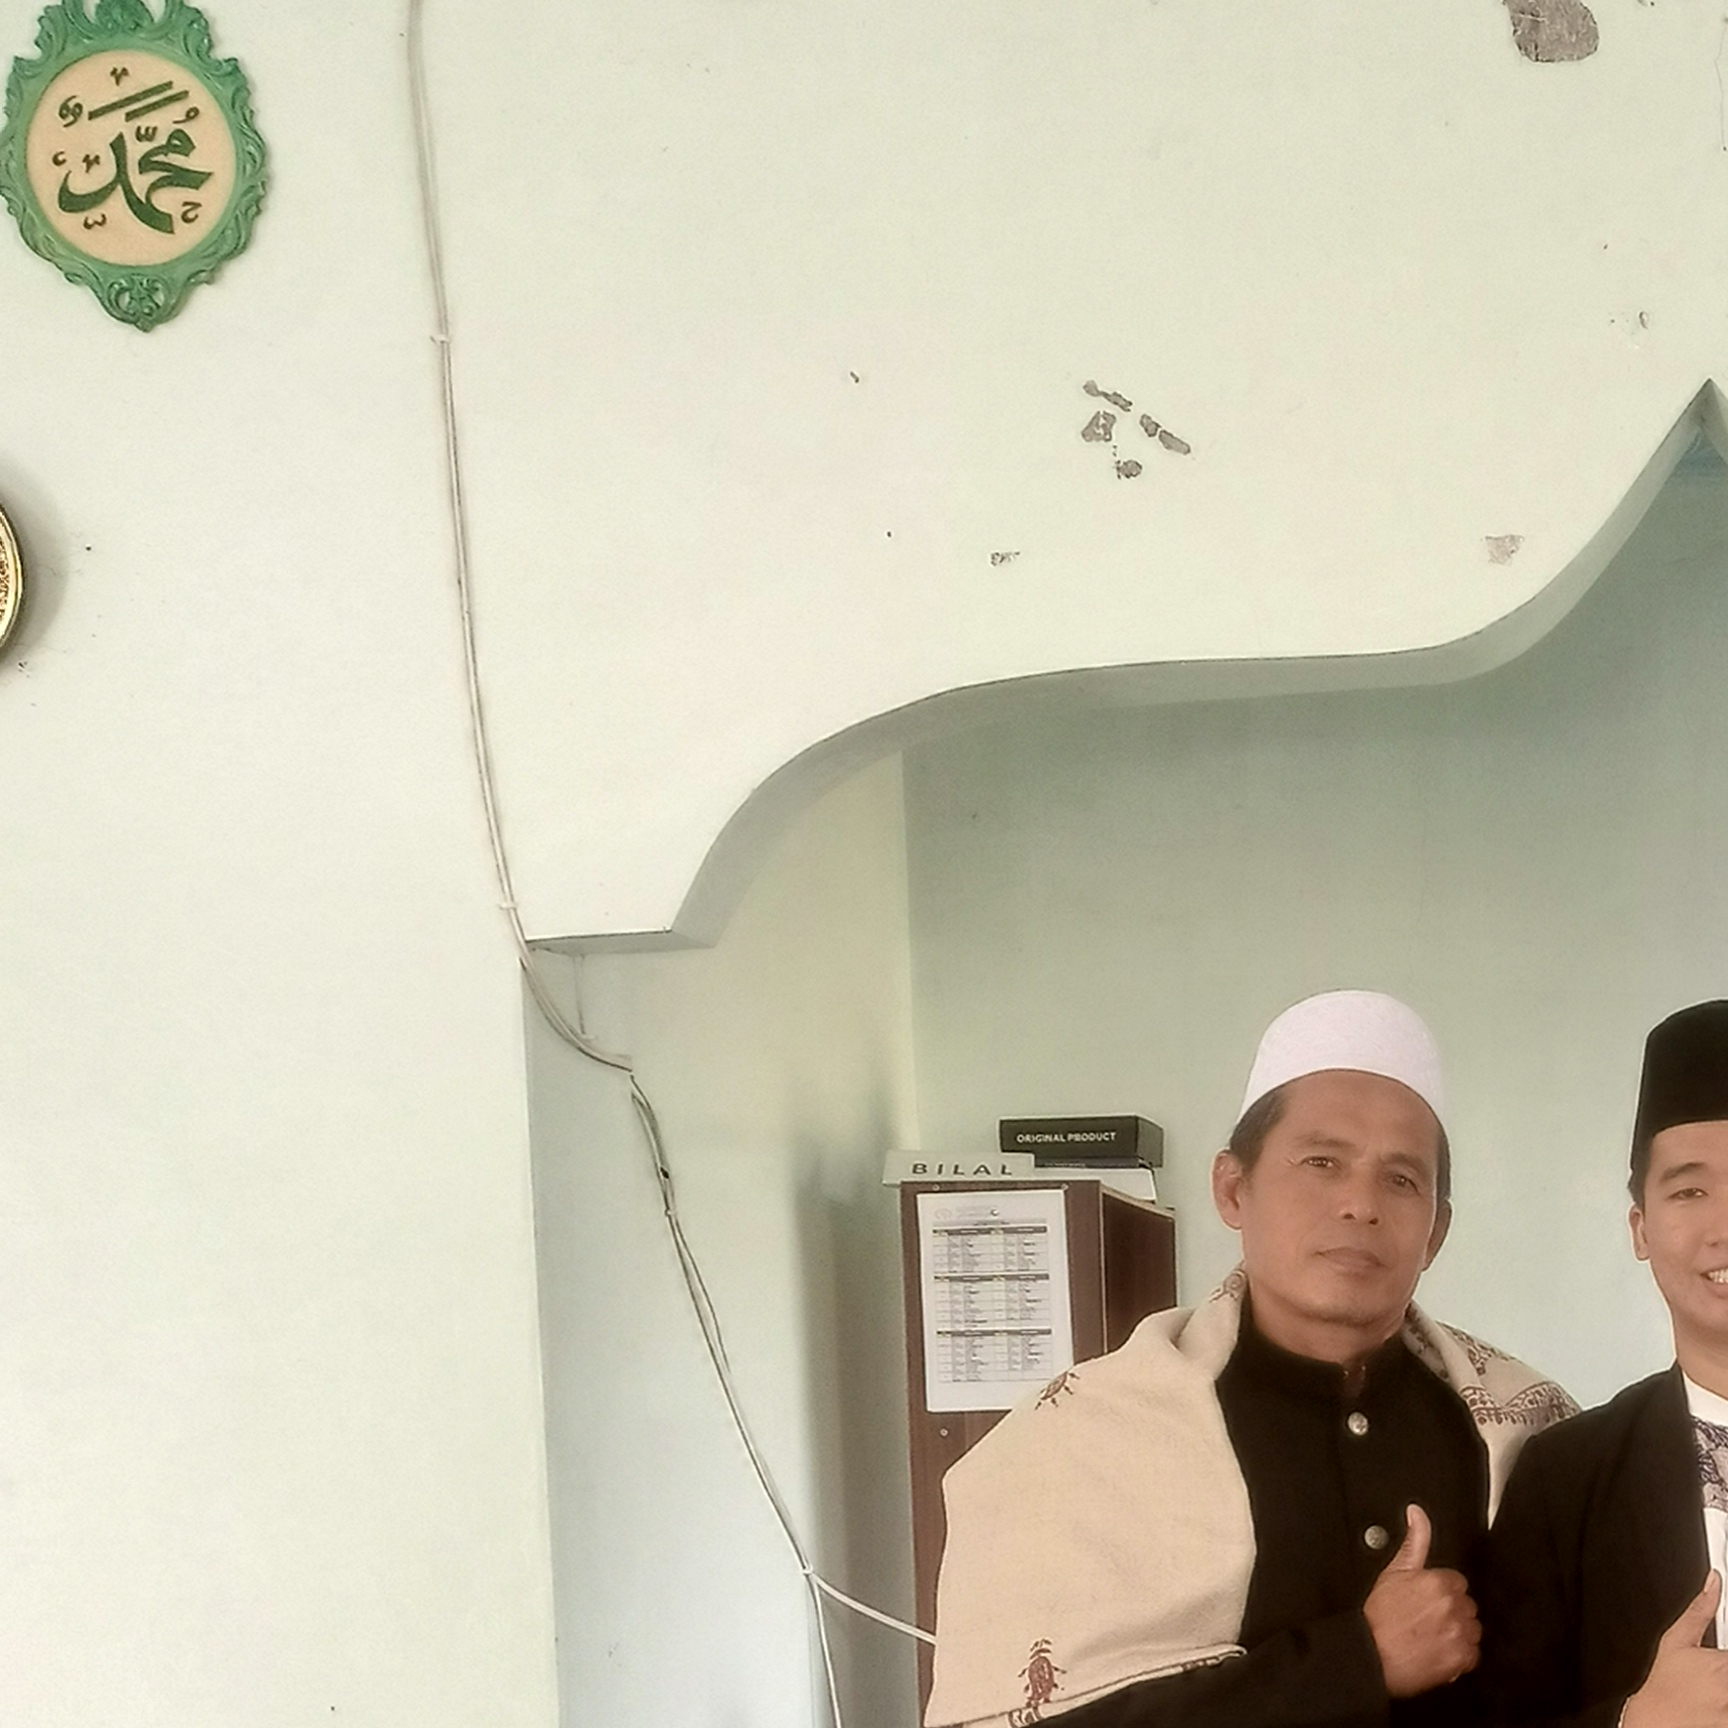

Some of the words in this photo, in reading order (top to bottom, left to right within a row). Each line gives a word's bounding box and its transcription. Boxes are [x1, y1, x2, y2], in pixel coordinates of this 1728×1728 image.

[1016, 1133, 1066, 1144] ORIGINAL
[1067, 1131, 1117, 1143] PRODUCT
[911, 1162, 1013, 1176] BILAL
